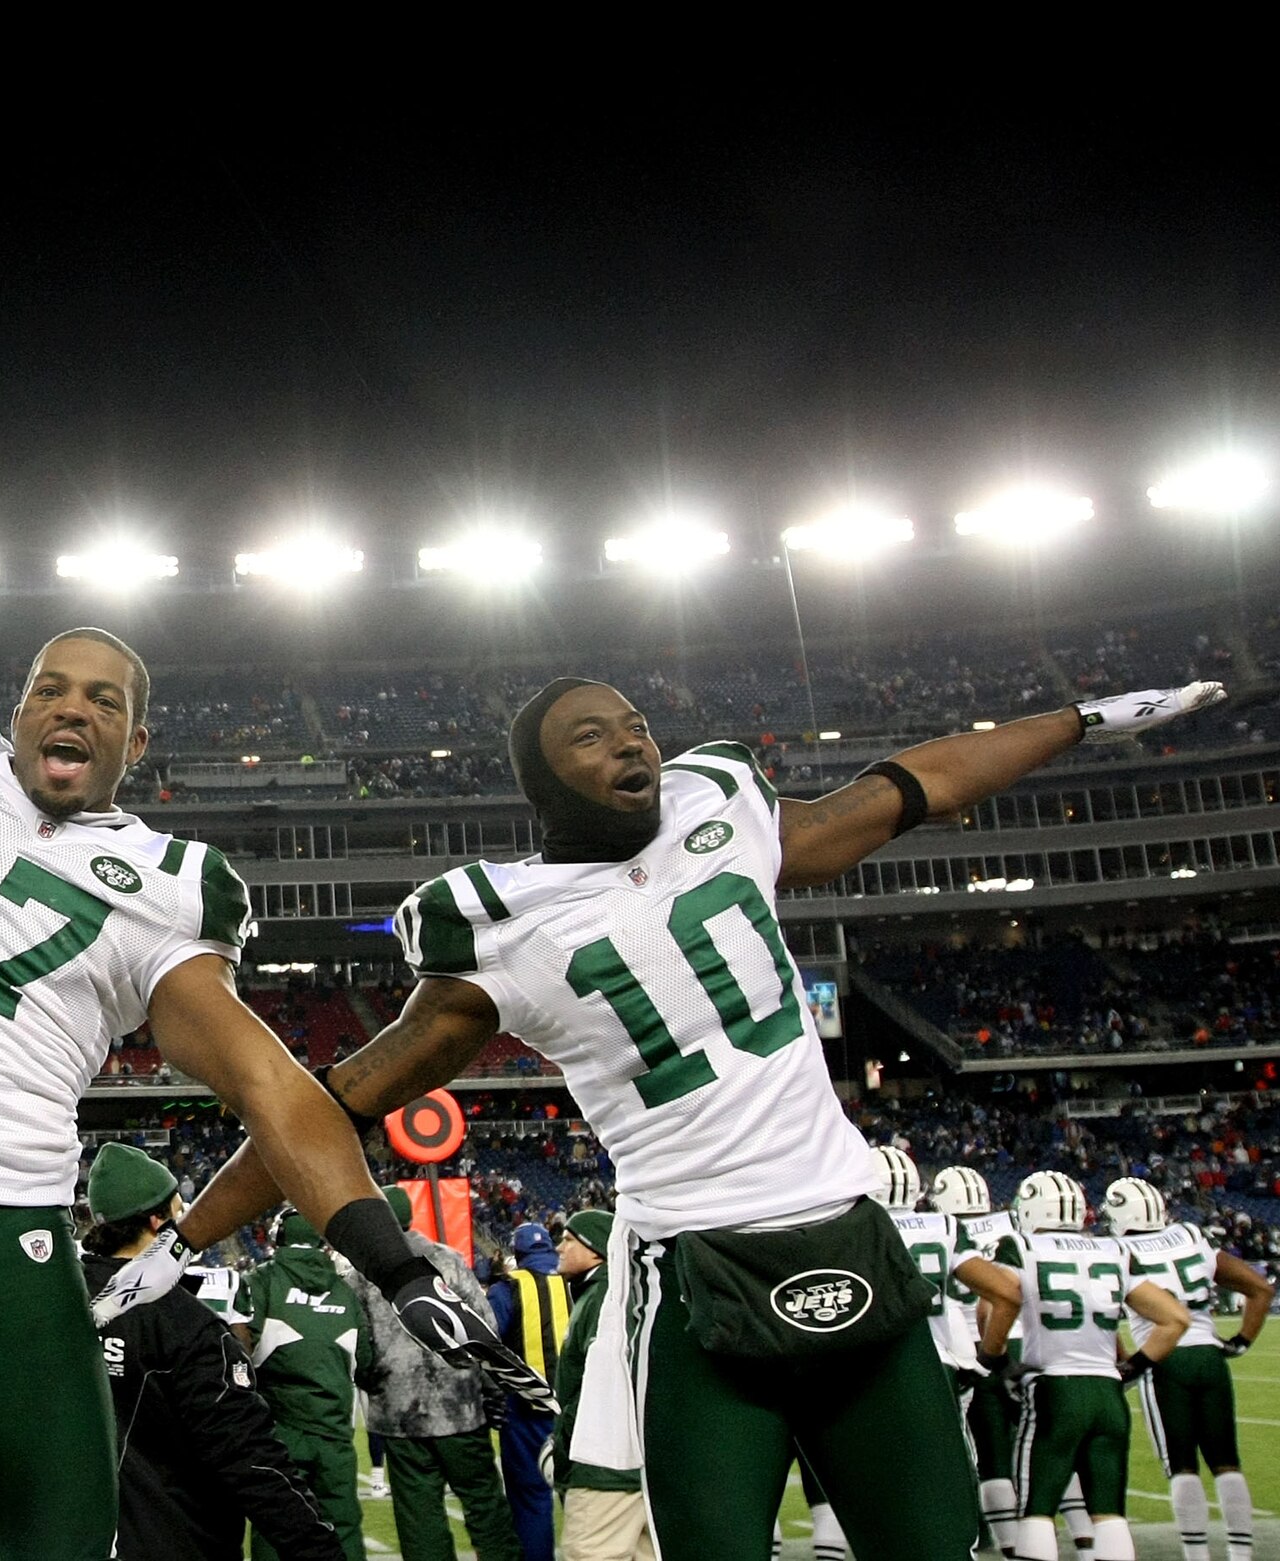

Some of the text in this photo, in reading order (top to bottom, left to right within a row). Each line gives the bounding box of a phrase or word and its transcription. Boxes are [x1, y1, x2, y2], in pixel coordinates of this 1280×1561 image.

[691, 827, 725, 848] JETS
[97, 860, 134, 885] JETS
[565, 871, 804, 1109] 10
[894, 1218, 926, 1229] NER
[286, 1287, 331, 1307] NY
[785, 1288, 853, 1312] JETS
[1037, 1261, 1123, 1331] 53
[313, 1305, 346, 1314] JETS
